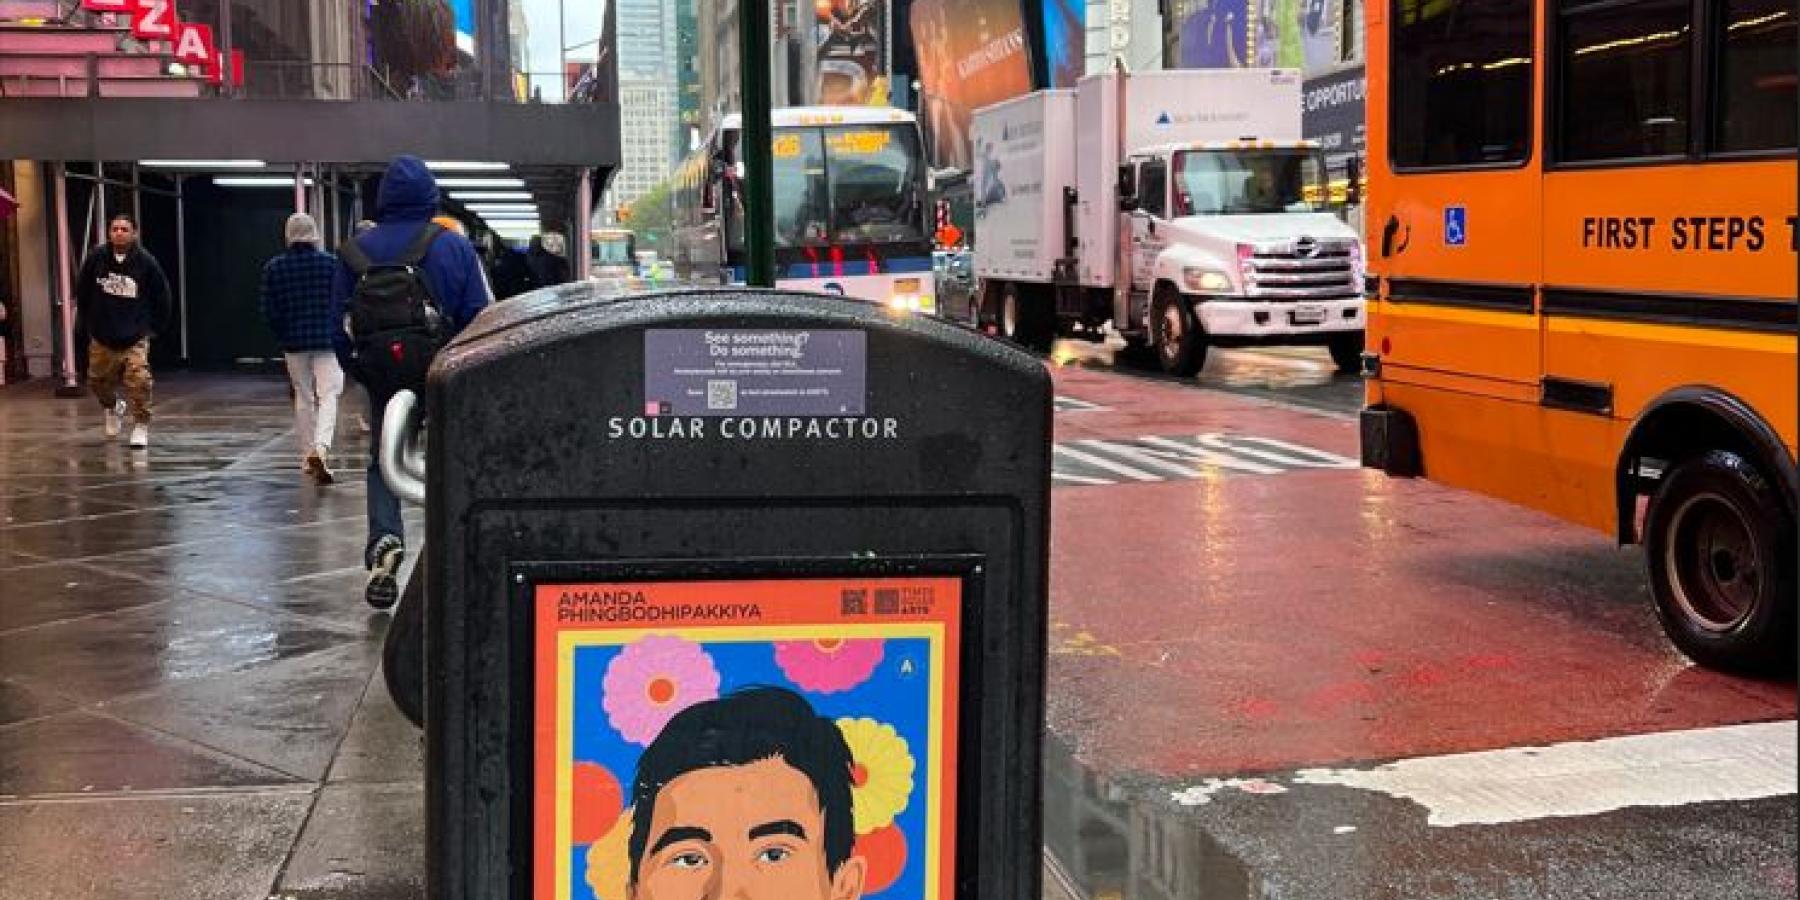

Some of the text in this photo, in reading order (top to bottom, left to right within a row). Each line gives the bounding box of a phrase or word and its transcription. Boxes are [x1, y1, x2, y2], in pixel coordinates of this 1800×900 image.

[1582, 217, 1656, 249] FIRST
[1671, 217, 1765, 252] STEPS
[705, 331, 810, 348] See something?
[709, 345, 728, 356] Do
[608, 417, 899, 440] SOLAR COMPACTOR
[557, 591, 648, 606] AMANDA
